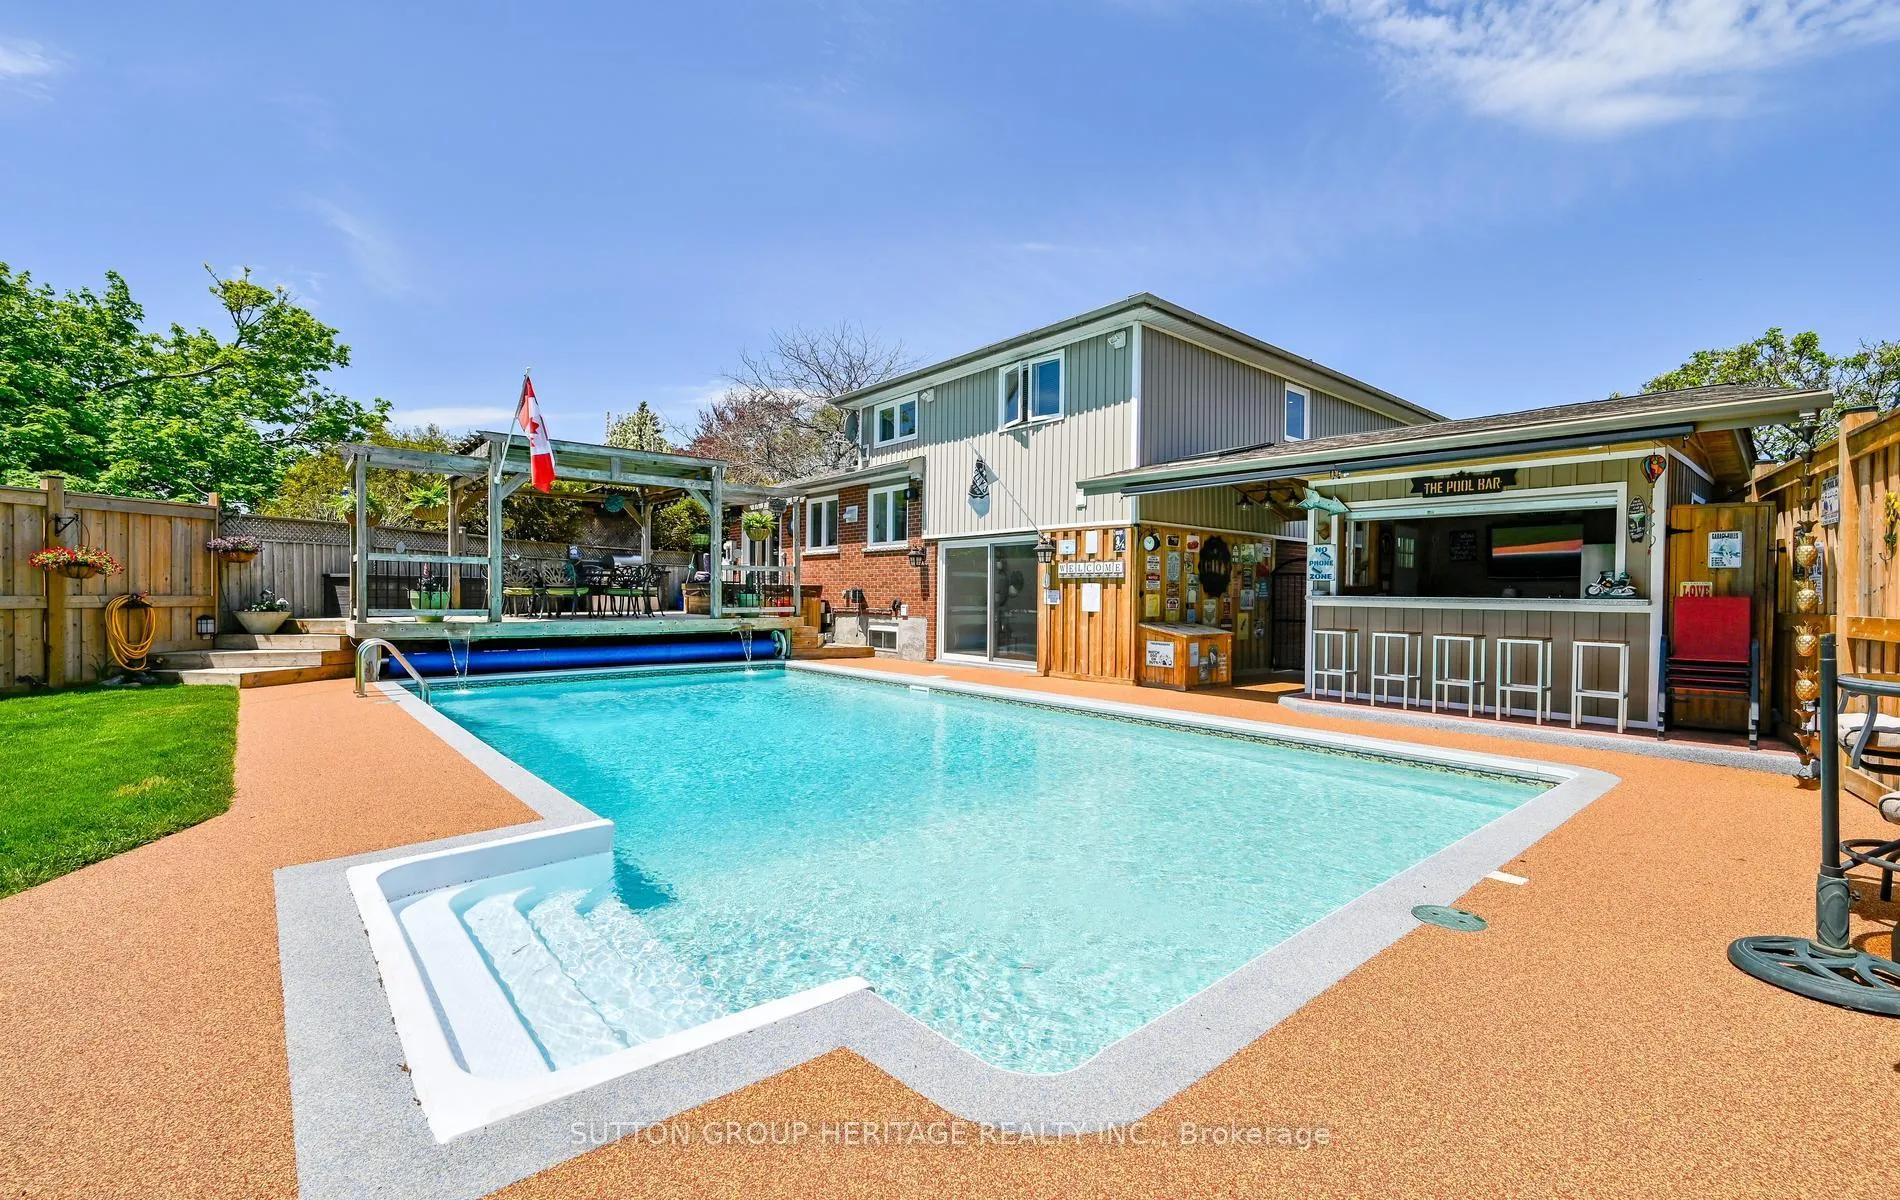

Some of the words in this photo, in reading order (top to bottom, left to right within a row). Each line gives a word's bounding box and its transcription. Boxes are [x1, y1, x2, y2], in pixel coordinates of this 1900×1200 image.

[1424, 482, 1444, 494] THE
[1446, 480, 1475, 493] POOL
[1478, 477, 1501, 490] BAR
[1060, 563, 1121, 573] WELCOME
